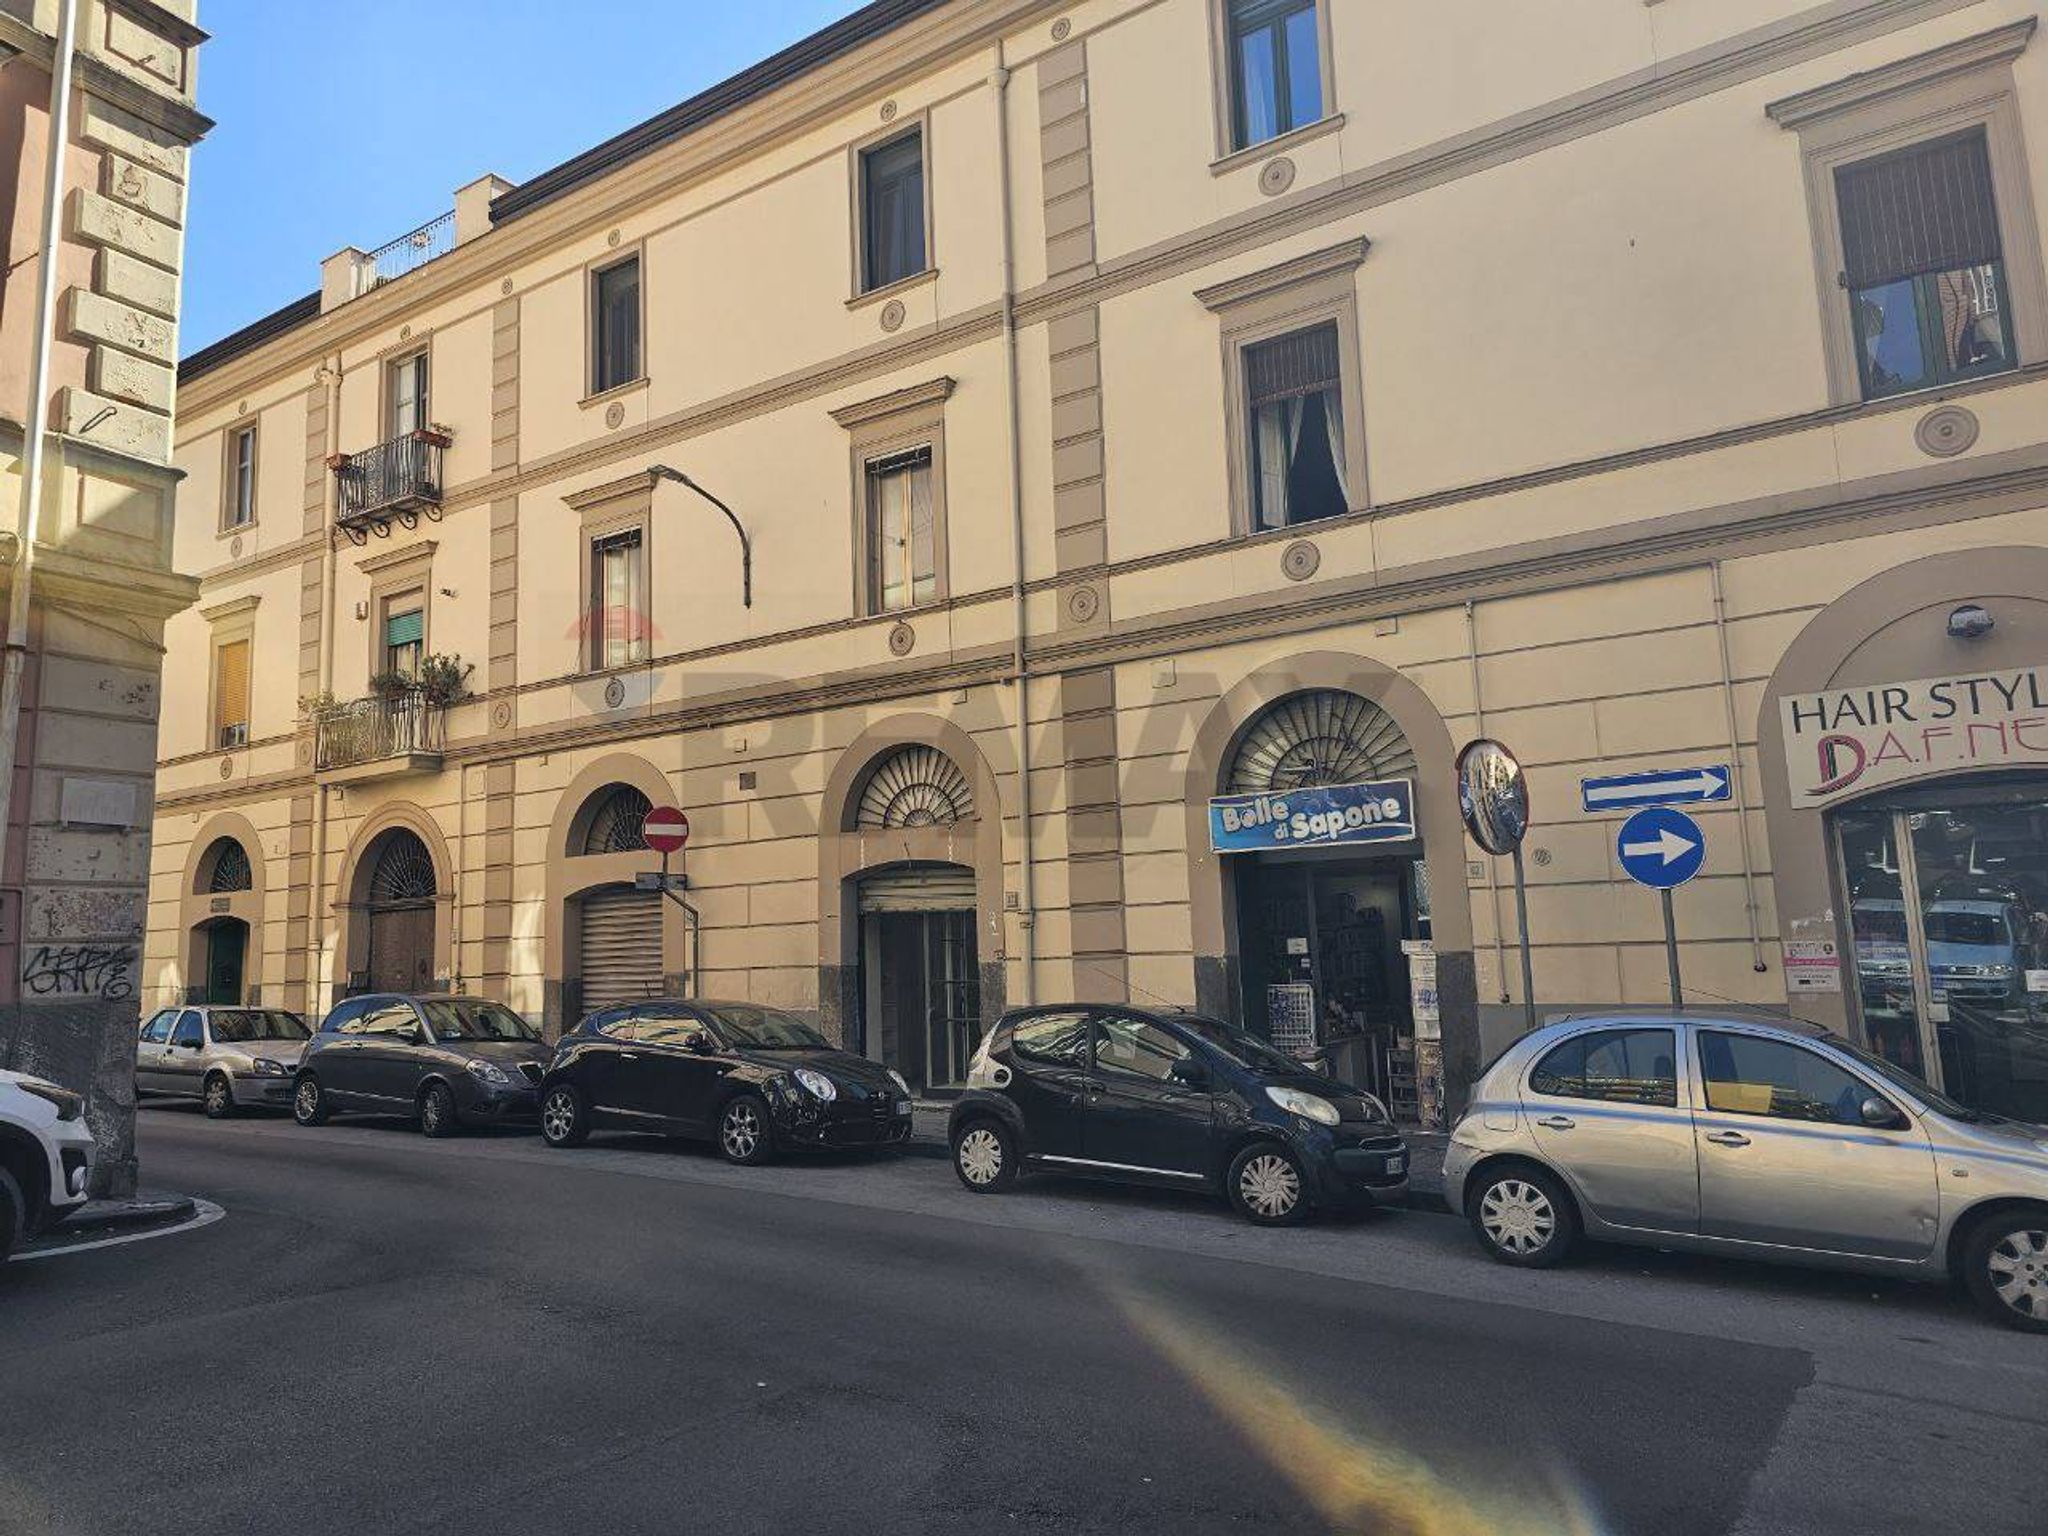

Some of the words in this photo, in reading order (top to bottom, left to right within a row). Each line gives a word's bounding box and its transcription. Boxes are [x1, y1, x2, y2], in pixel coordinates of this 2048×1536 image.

[1792, 687, 1918, 734] HAIR
[1221, 797, 1290, 832] Bolle
[1274, 822, 1290, 841] di
[1291, 797, 1402, 840] Sapone
